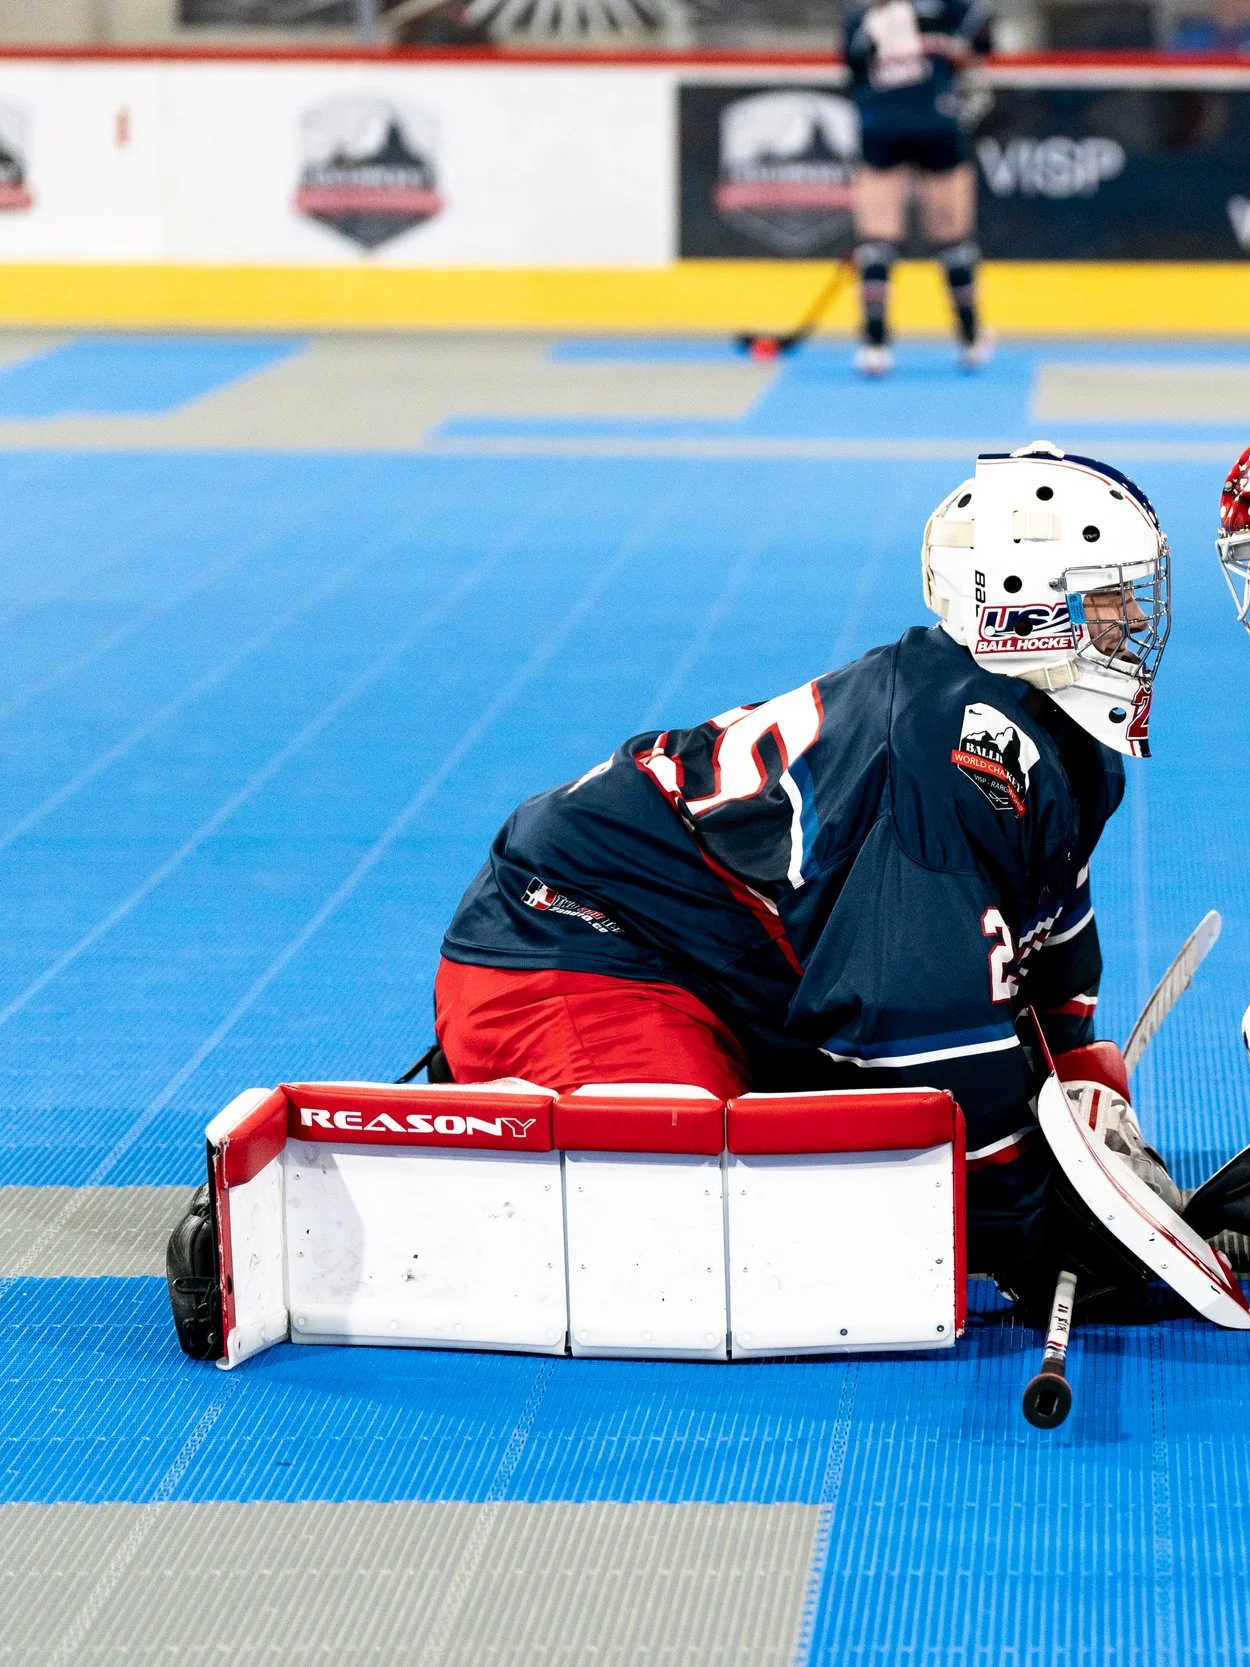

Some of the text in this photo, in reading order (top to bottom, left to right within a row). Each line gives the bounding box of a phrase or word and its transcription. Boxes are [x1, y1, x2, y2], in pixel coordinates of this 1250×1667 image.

[976, 134, 1126, 198] VISP
[976, 635, 1080, 653] BALL HOCKEY
[980, 906, 1018, 1004] 2
[300, 1107, 537, 1138] REASONY
